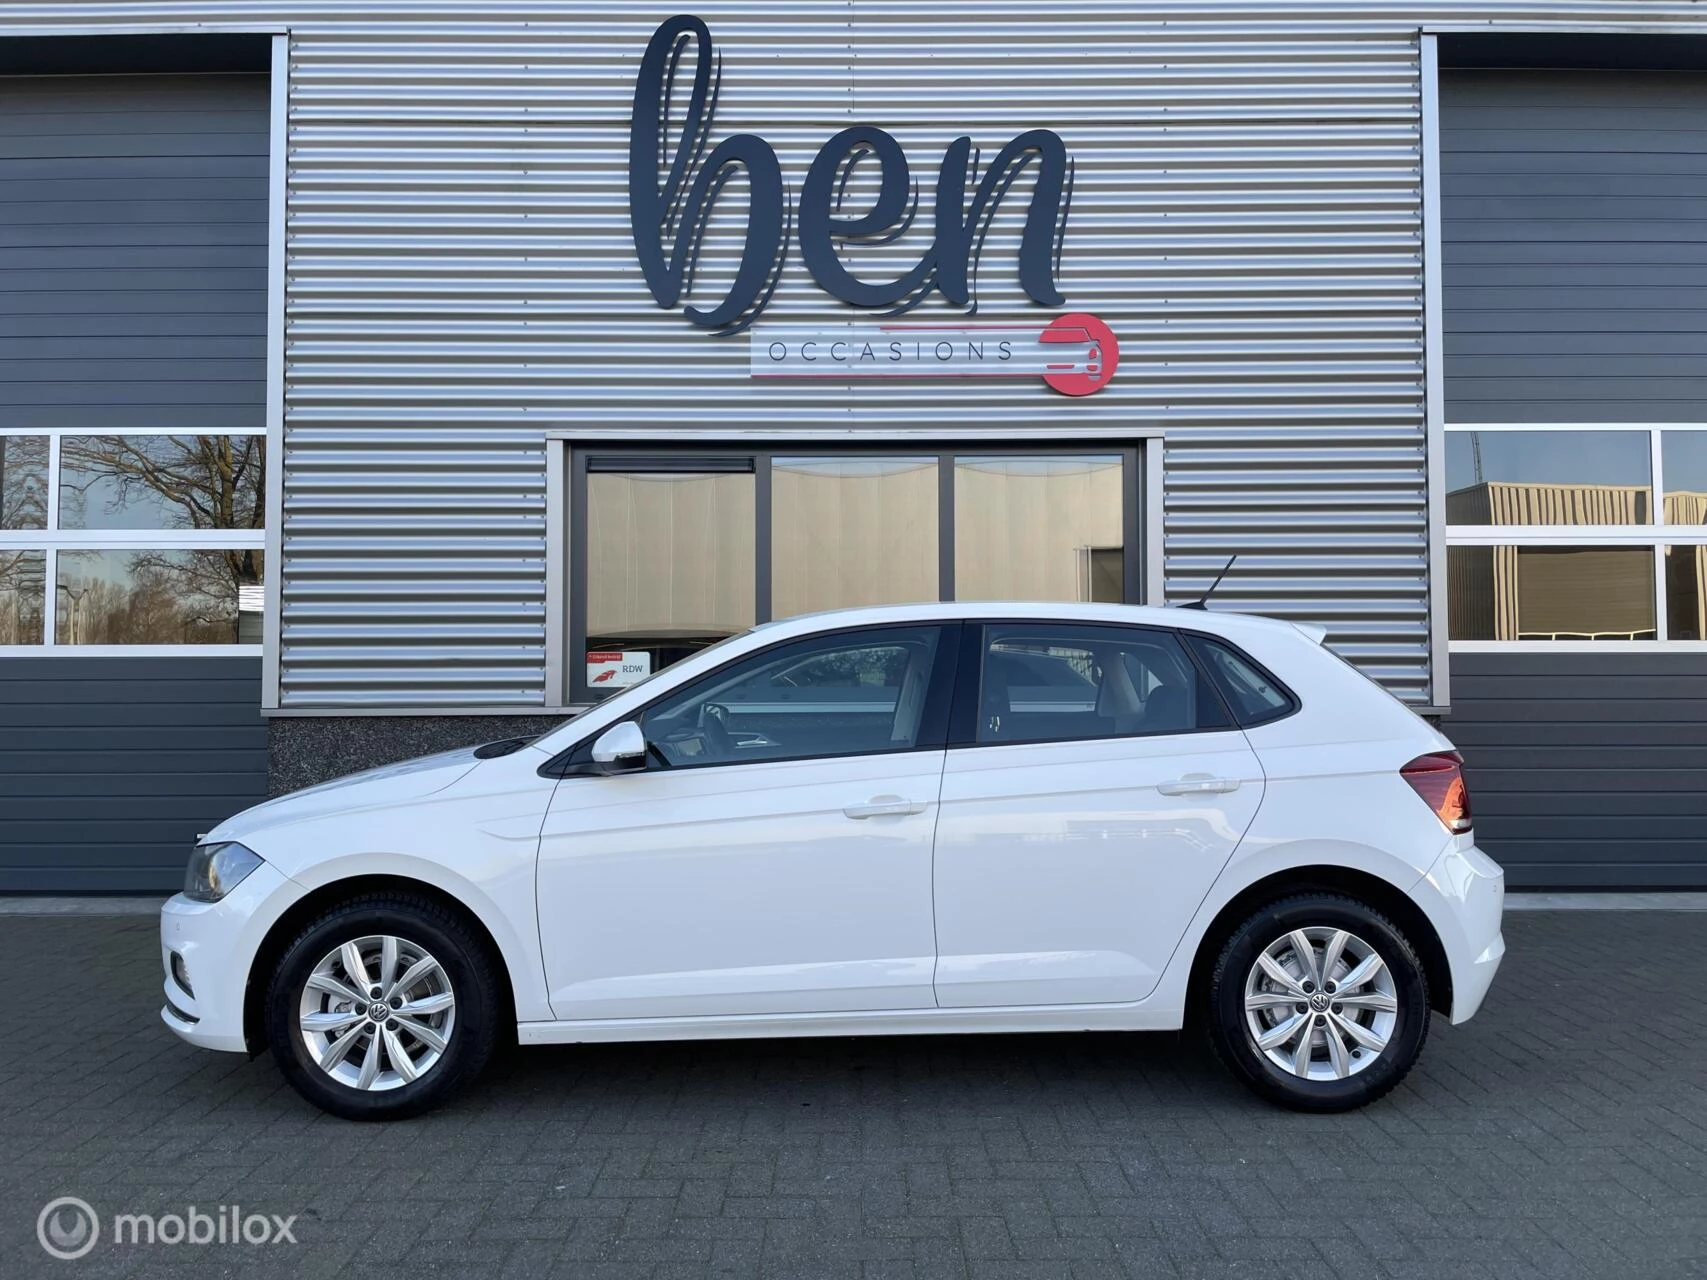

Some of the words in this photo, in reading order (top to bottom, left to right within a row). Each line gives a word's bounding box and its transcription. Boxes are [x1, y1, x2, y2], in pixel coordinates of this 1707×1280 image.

[630, 15, 1074, 336] ben
[768, 341, 1013, 361] OCCASIONS
[622, 665, 643, 673] RDW
